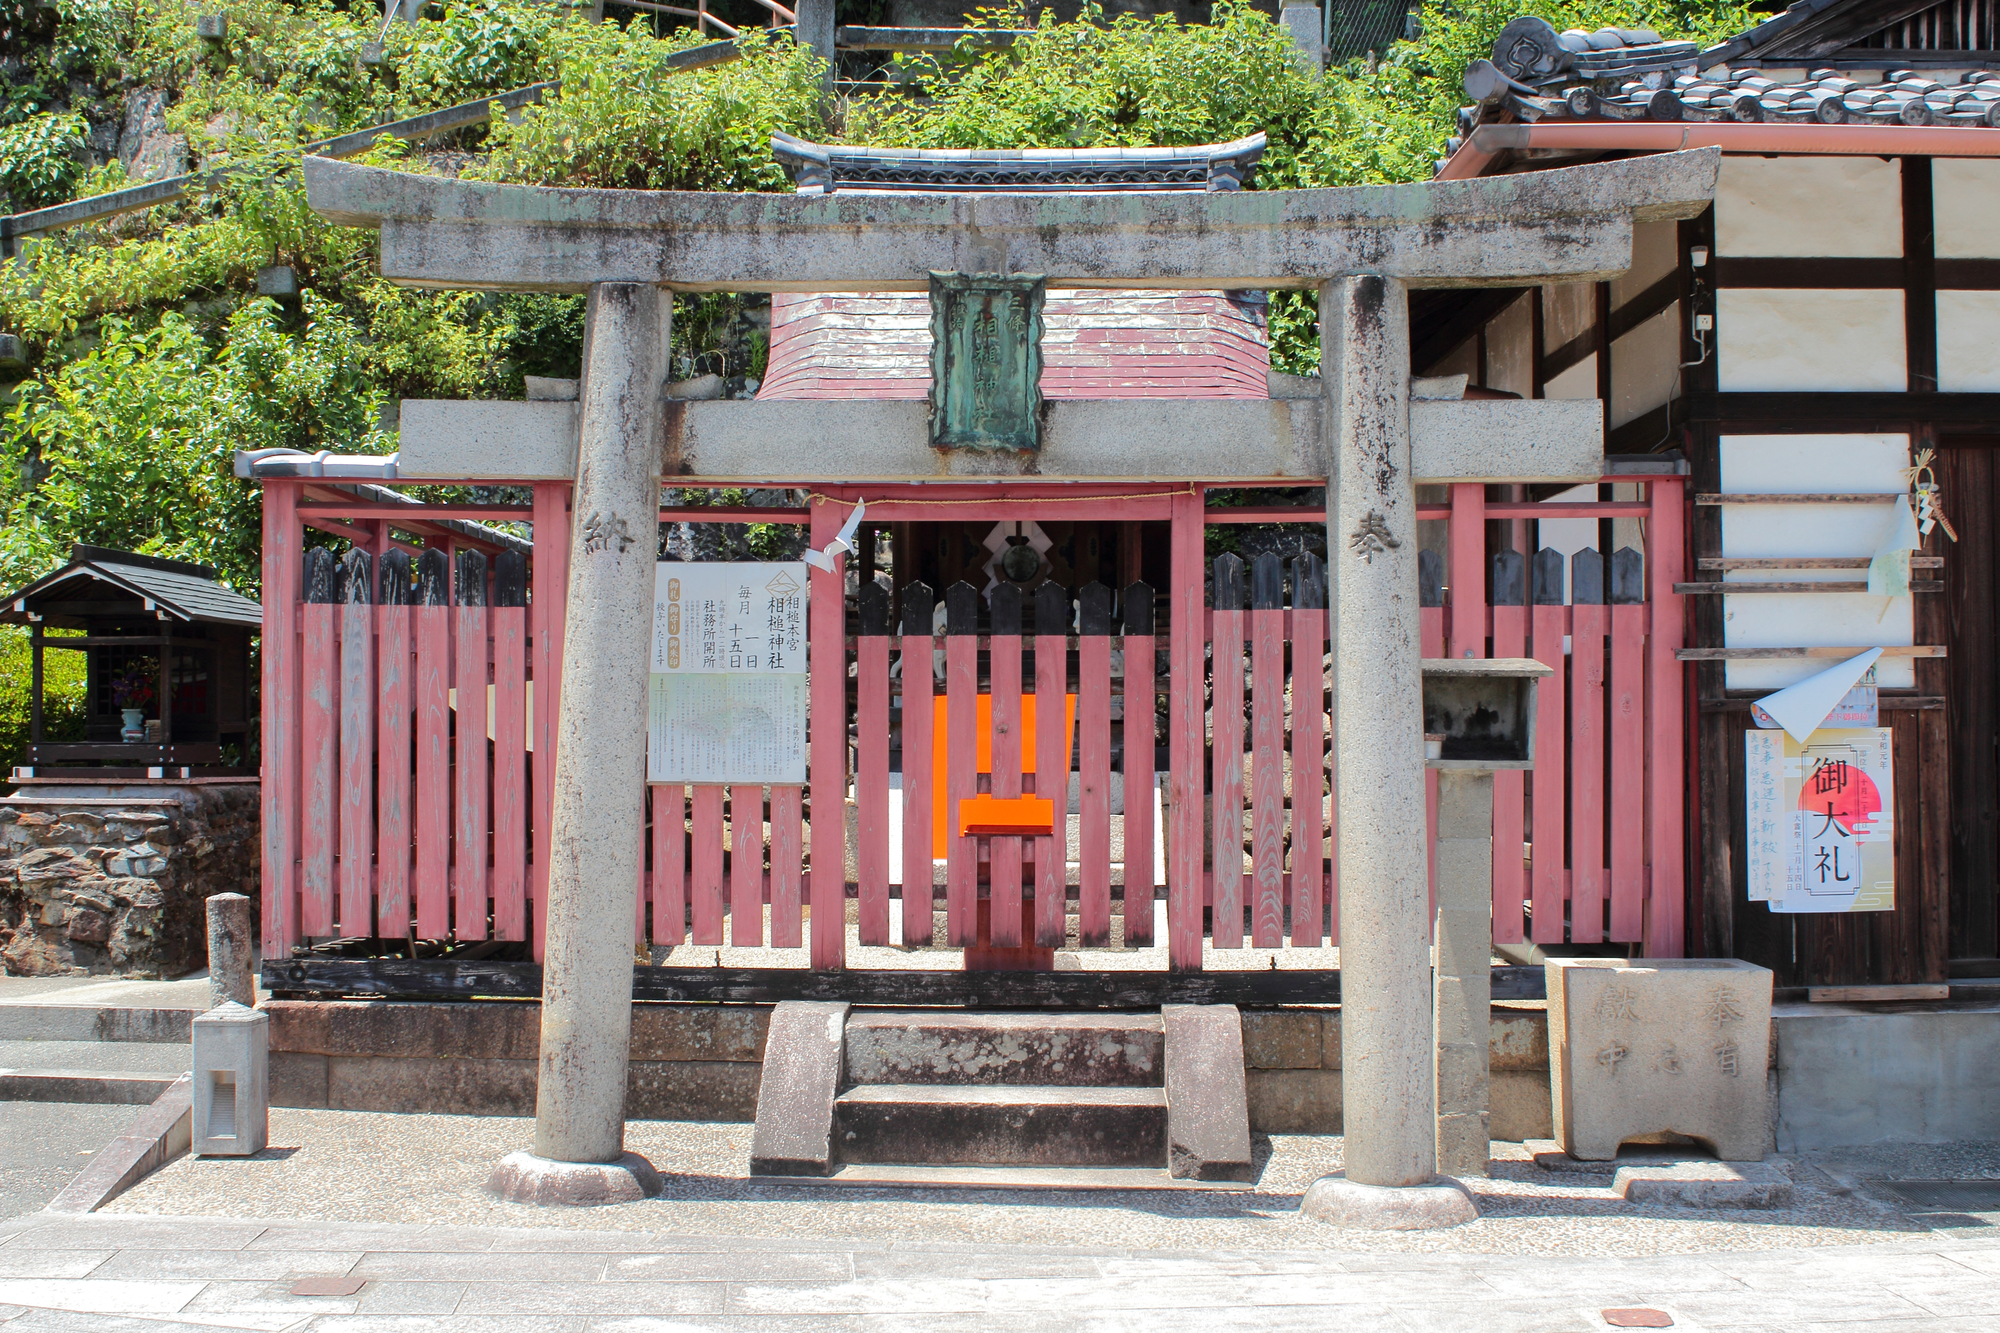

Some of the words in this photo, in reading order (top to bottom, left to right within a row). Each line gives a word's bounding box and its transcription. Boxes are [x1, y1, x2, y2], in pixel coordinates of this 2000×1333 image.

[1006, 297, 1026, 331] 三條
[973, 313, 998, 419] 相槌神社
[584, 511, 636, 555] 納
[1348, 511, 1401, 564] 奉
[669, 581, 679, 600] 御札
[738, 585, 752, 615] 毎月
[656, 602, 666, 667] 授与いたします
[669, 606, 679, 633] 御守り
[703, 600, 717, 668] 社務所開所
[767, 597, 785, 669] 相槌神社
[786, 596, 800, 652] 相槌本宮
[669, 639, 679, 667] 御朱印
[729, 623, 743, 668] 十五日
[1879, 731, 1888, 769] 令和元年
[1811, 757, 1850, 883] 御大礼
[1786, 866, 1794, 890] 十五日
[1794, 842, 1803, 890] 十一月十四日
